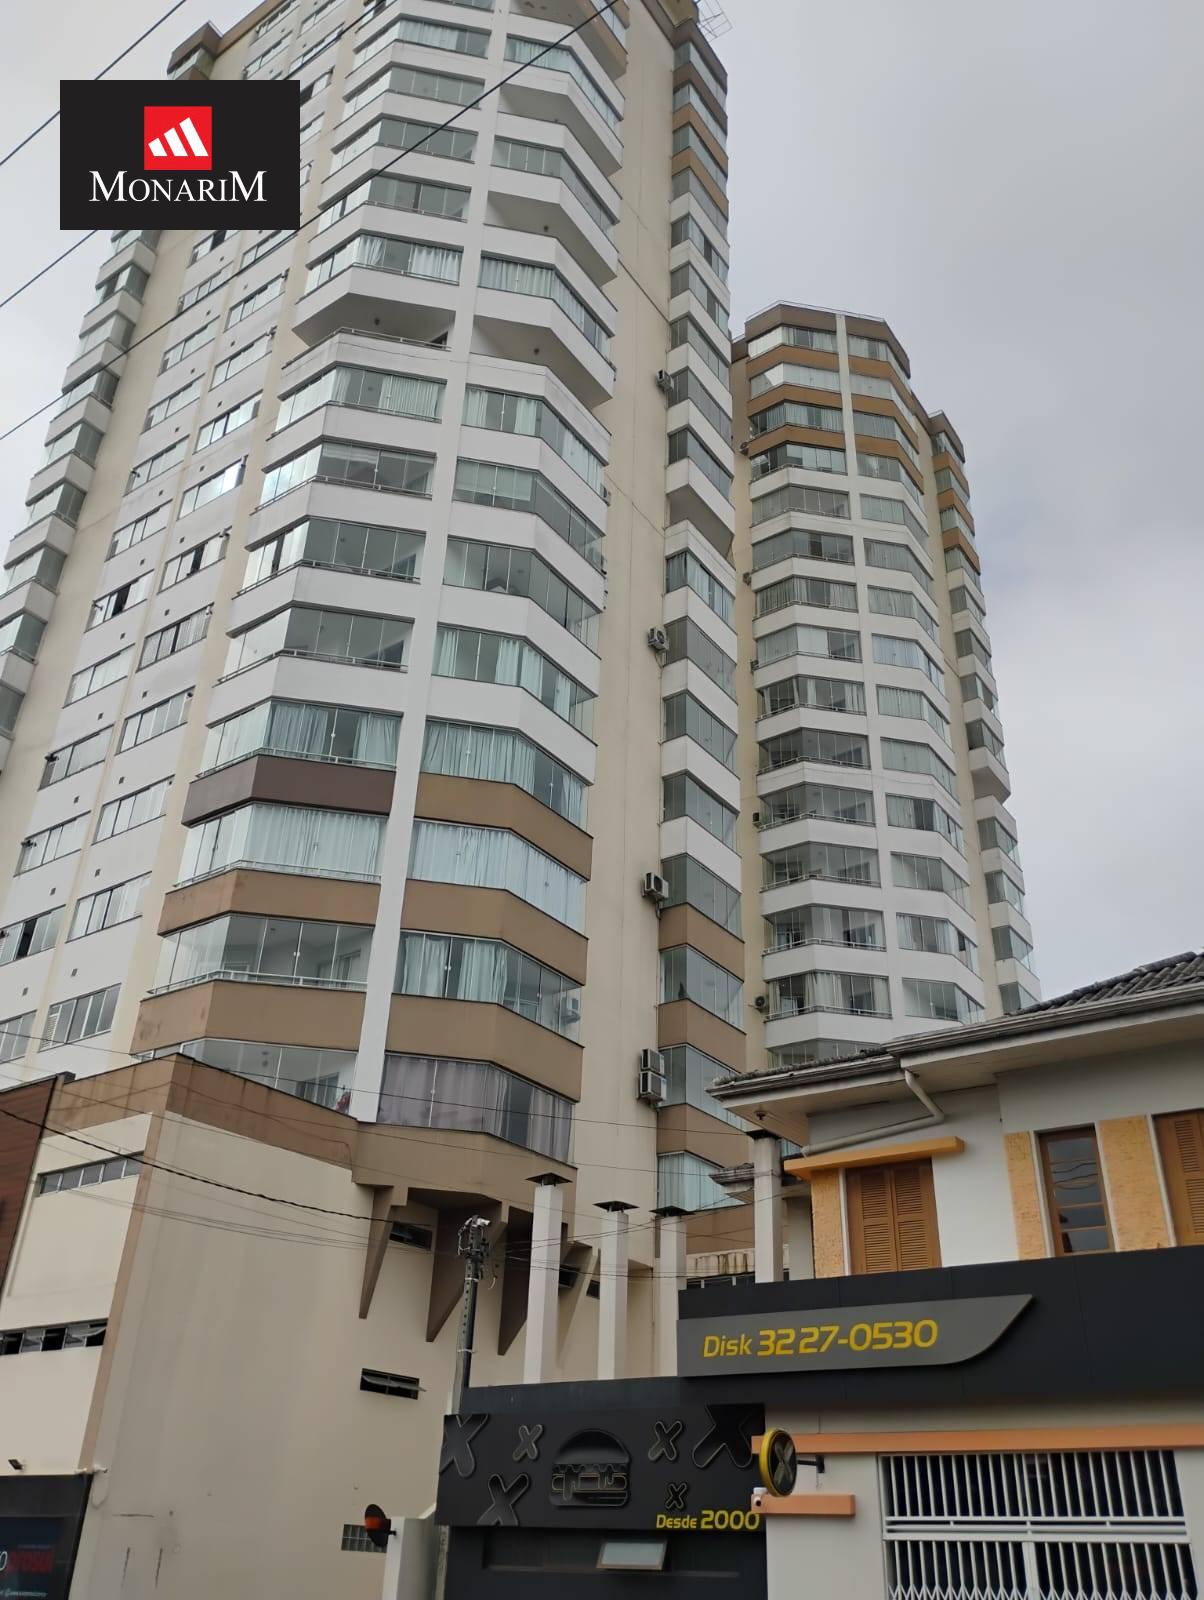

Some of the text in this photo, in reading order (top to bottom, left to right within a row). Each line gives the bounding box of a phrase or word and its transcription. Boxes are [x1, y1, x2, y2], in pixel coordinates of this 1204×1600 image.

[703, 1319, 938, 1357] Disk 3227-0530
[656, 1510, 760, 1530] Desde 2000
